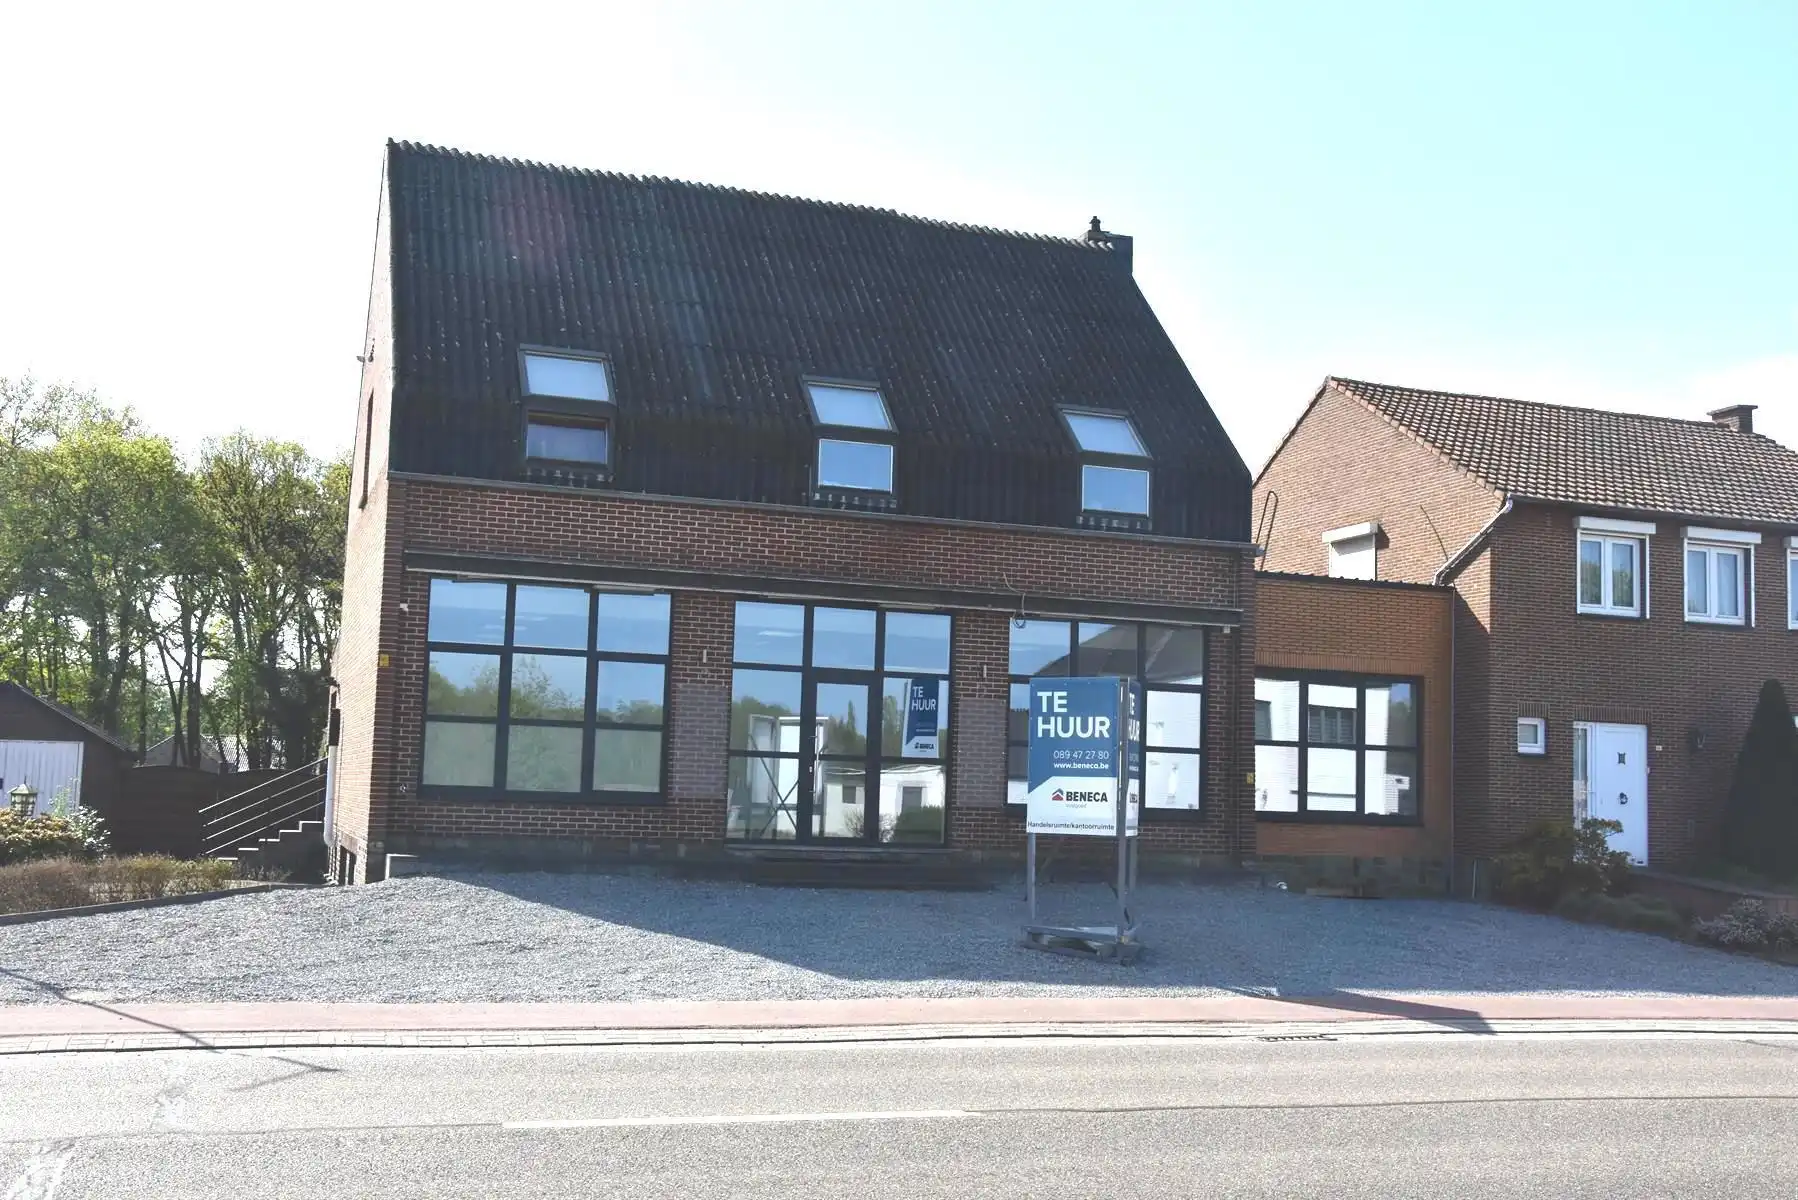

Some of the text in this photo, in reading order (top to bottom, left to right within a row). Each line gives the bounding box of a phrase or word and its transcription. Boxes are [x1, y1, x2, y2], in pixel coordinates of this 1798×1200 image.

[912, 686, 924, 698] TE
[911, 699, 937, 711] HUUR
[1037, 691, 1068, 713] TE
[1037, 716, 1111, 738] HUUR
[1053, 750, 1071, 760] 089
[1072, 750, 1083, 760] 47
[1086, 751, 1096, 760] 27
[1053, 762, 1110, 770] www.beneca.be
[1066, 791, 1108, 803] BENECA
